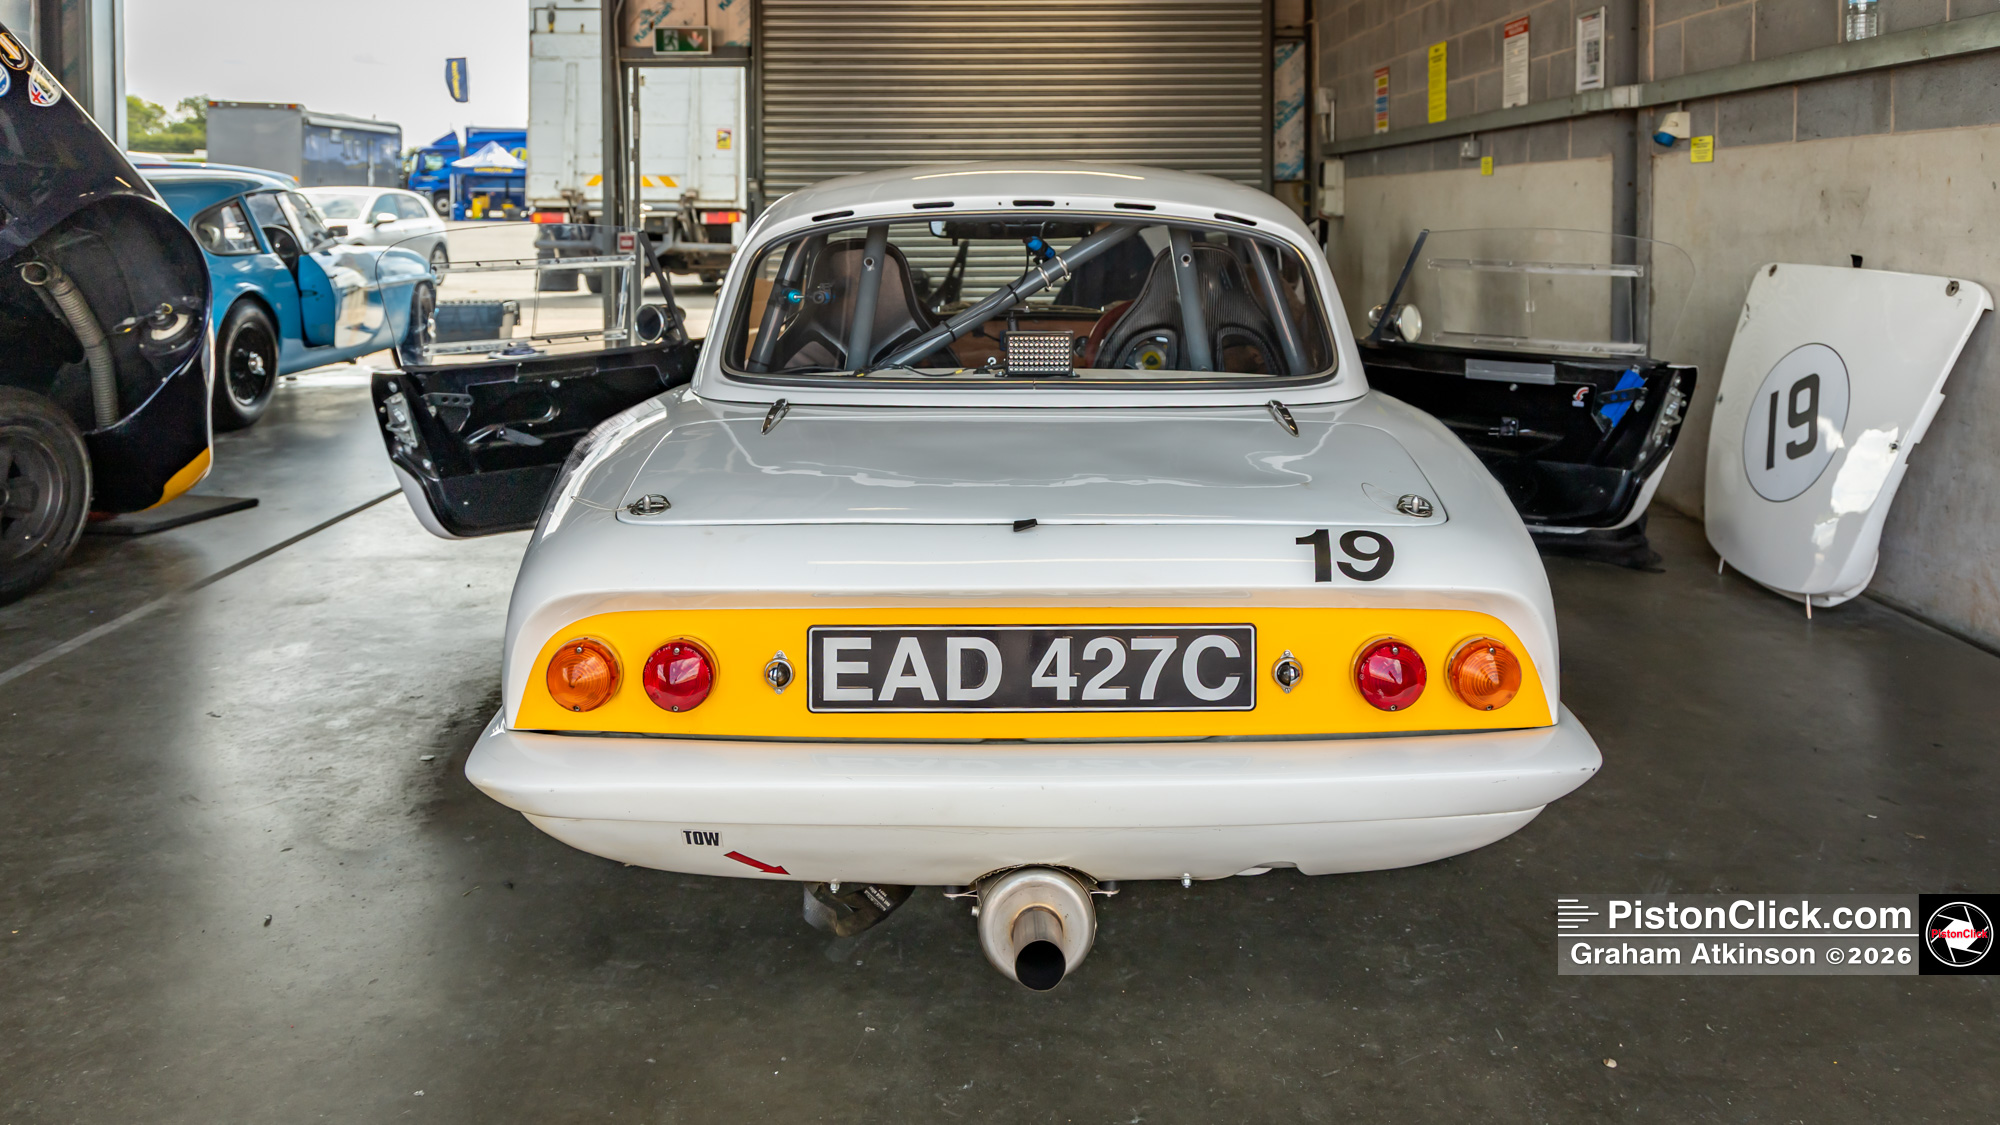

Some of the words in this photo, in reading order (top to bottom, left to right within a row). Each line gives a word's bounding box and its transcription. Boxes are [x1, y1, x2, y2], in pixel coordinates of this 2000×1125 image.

[1765, 372, 1821, 472] 19
[1295, 529, 1396, 582] 19
[822, 634, 1003, 701] EAD
[1030, 634, 1242, 701] 427C
[682, 830, 719, 847] TOW
